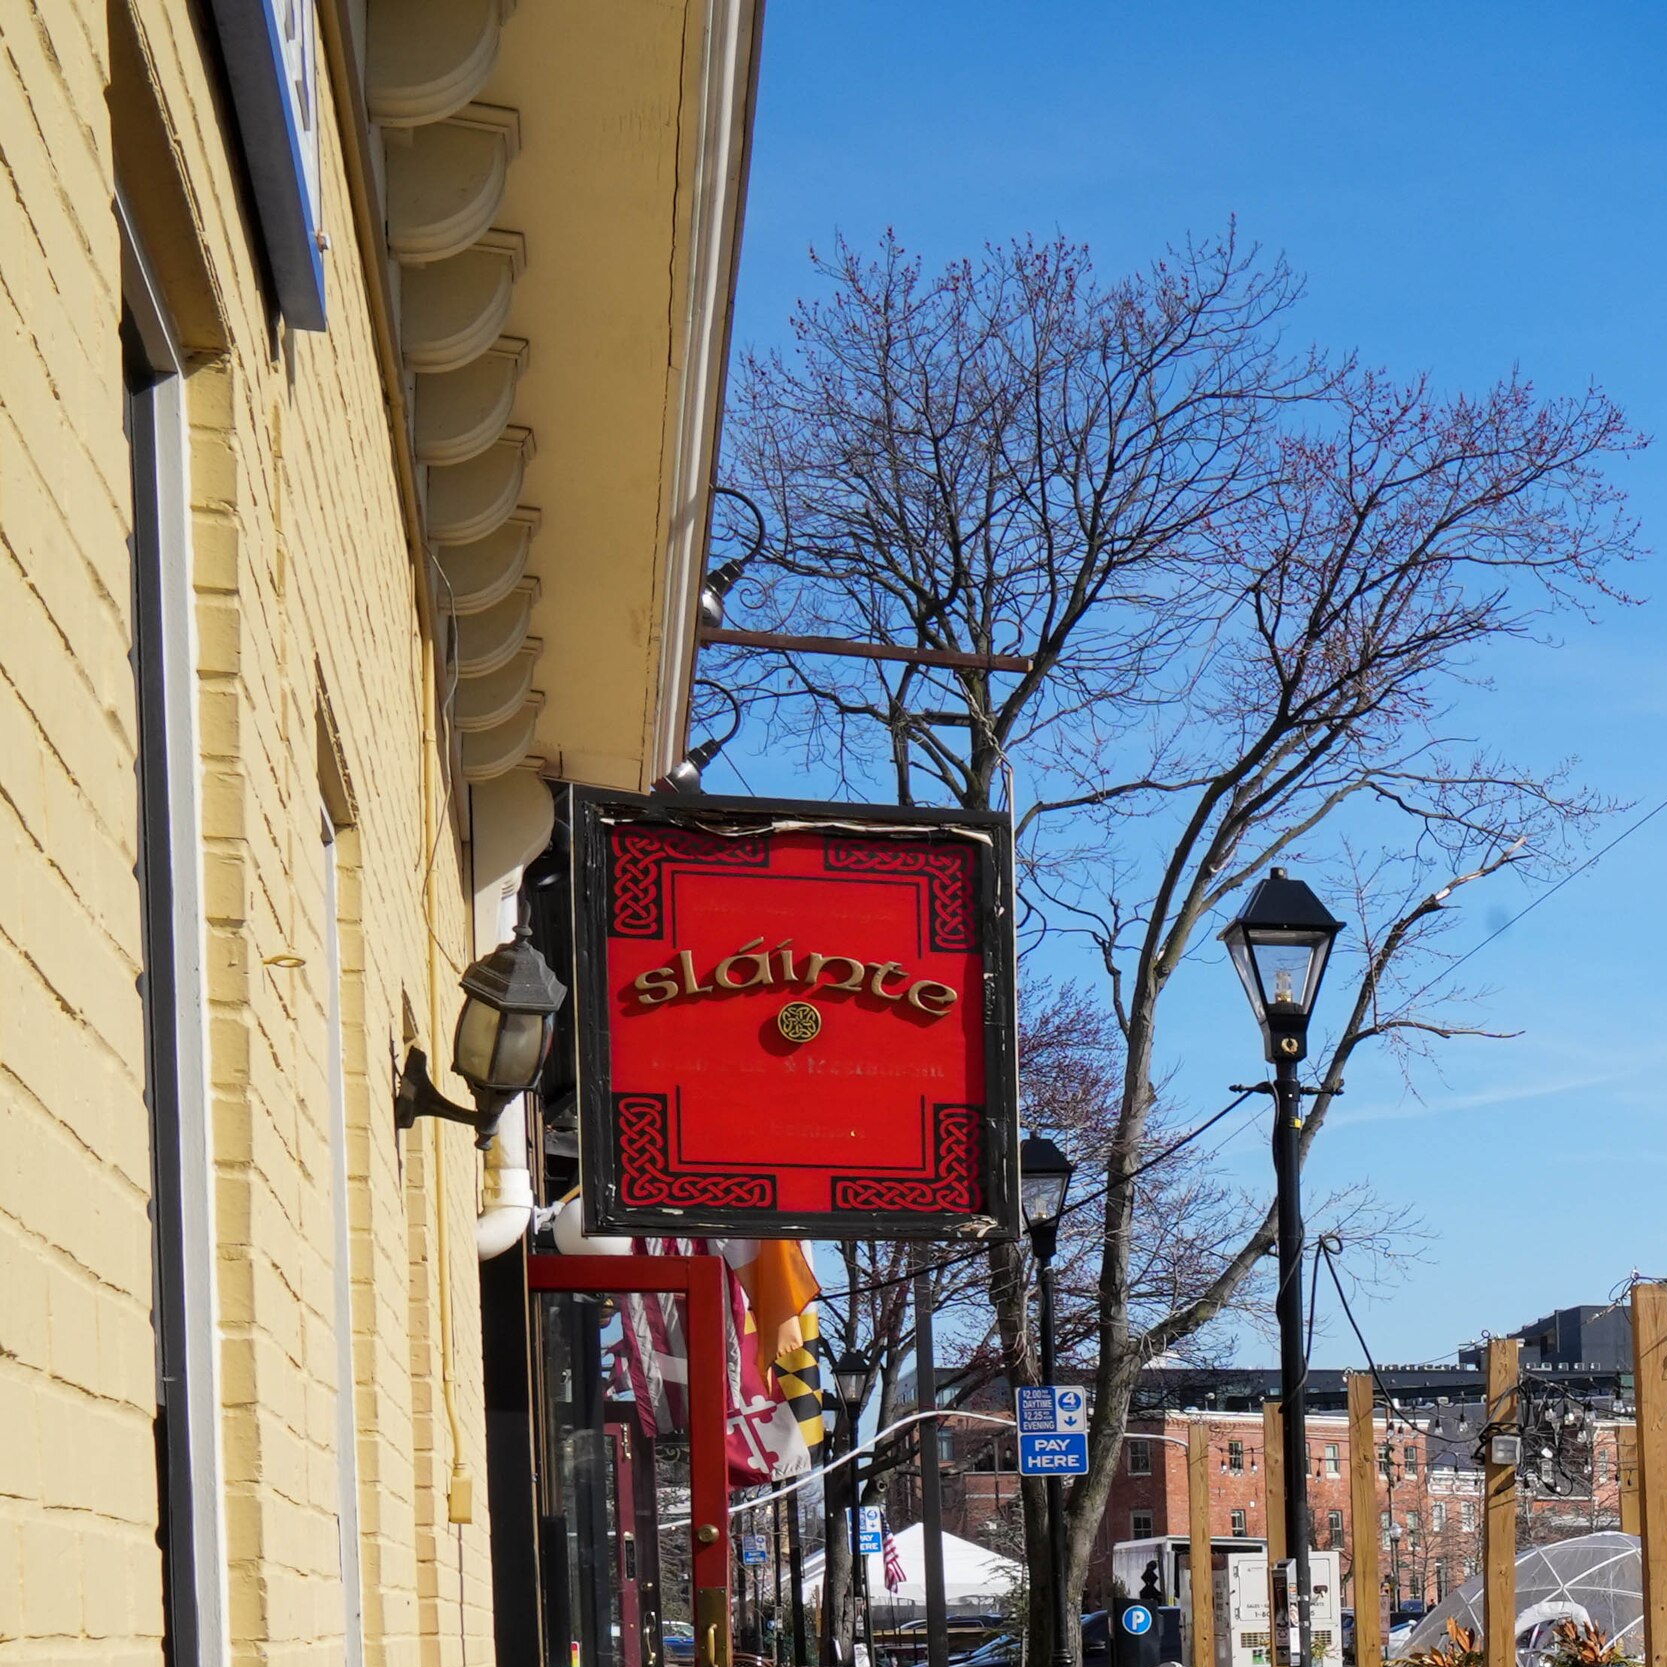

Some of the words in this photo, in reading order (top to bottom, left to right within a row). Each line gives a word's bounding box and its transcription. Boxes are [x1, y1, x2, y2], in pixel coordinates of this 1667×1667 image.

[634, 936, 958, 1016] sláinte
[1023, 1400, 1053, 1408] DAYTIME
[1062, 1393, 1076, 1405] 4
[1023, 1421, 1055, 1430] EVENING
[1034, 1439, 1071, 1452] PAY
[1027, 1454, 1080, 1468] HERE
[1132, 1610, 1145, 1630] P
